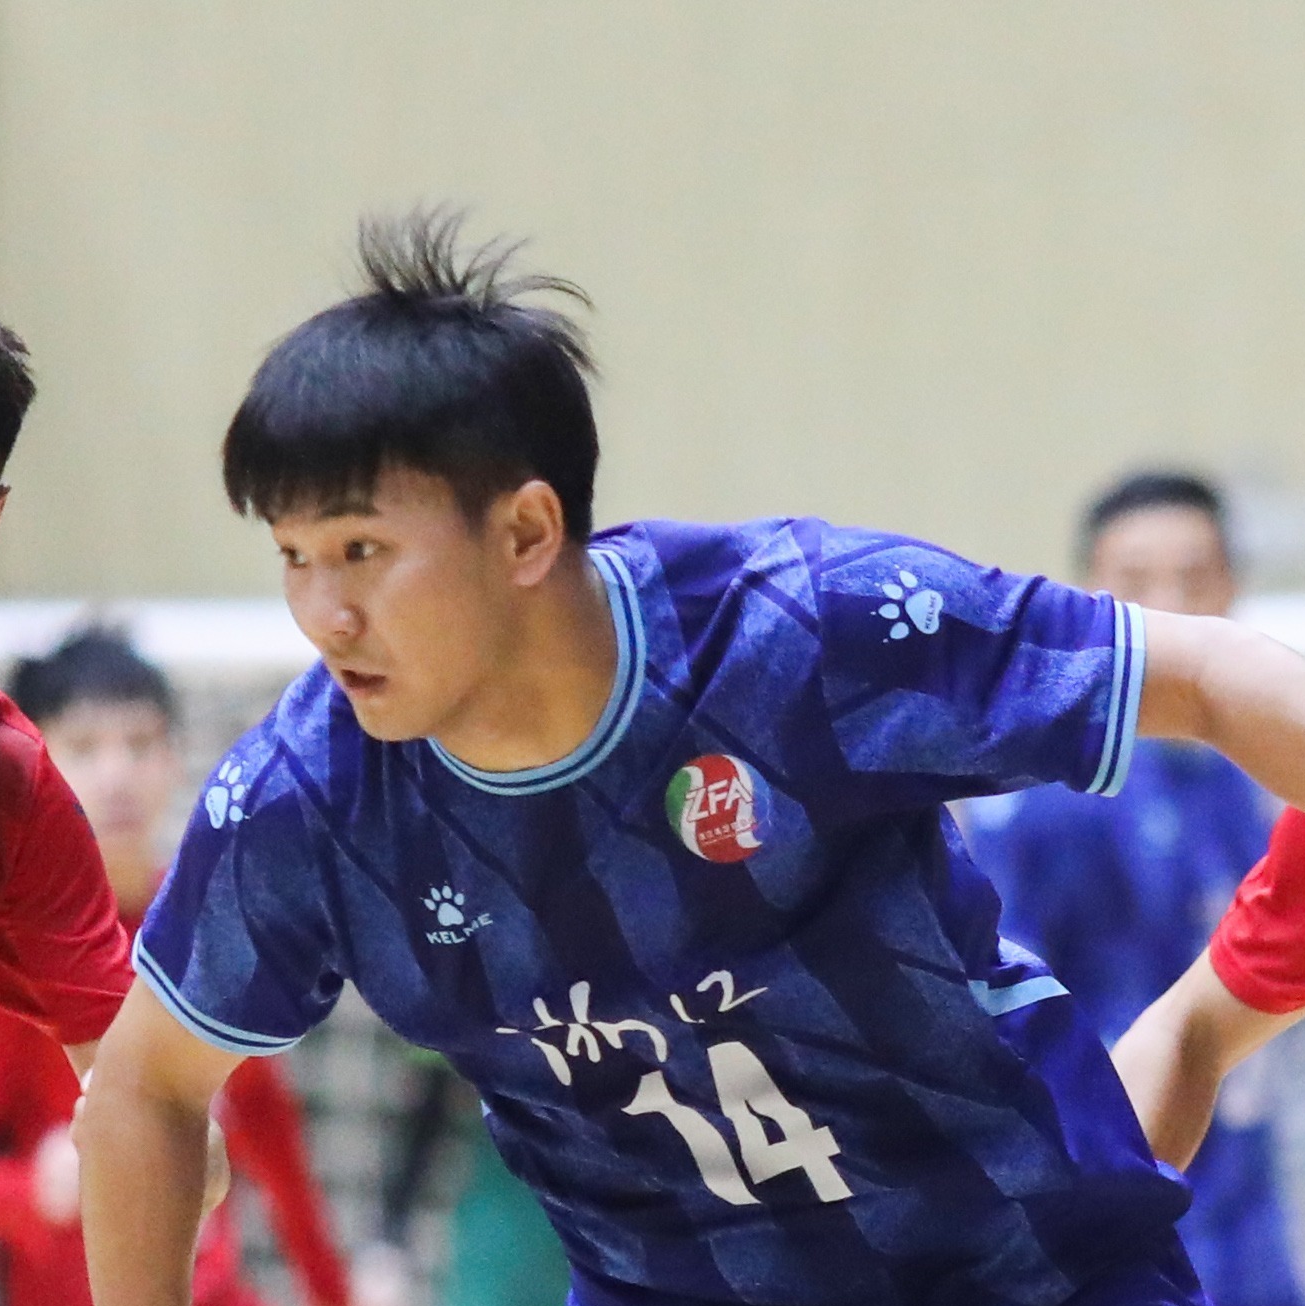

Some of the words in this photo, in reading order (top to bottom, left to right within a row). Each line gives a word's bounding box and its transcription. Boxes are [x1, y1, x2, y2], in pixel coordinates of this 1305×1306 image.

[685, 776, 754, 823] ZFA
[425, 912, 494, 944] KELME
[621, 1041, 854, 1205] 14
